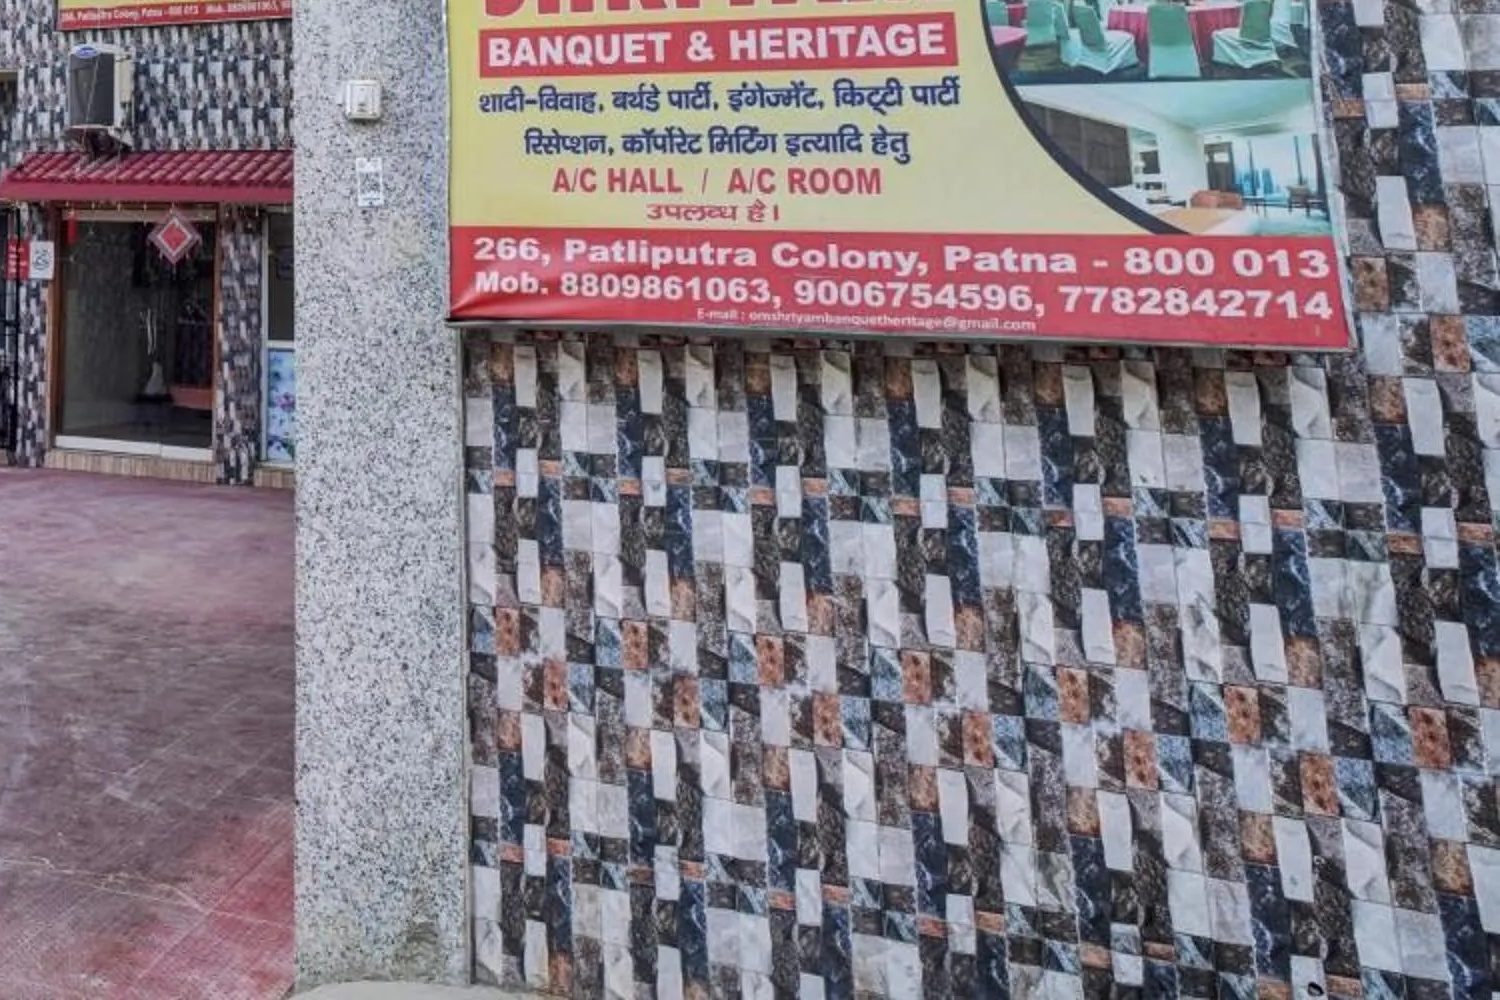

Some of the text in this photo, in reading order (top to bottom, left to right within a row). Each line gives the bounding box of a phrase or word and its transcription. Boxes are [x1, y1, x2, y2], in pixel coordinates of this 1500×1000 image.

[488, 22, 947, 68] BANQUET & HERITAGE
[909, 76, 961, 106] पार्टी
[783, 123, 864, 156] इत्यादि
[870, 124, 911, 164] हेतु
[552, 167, 598, 193] A/C
[607, 167, 683, 193] HALL
[726, 167, 776, 195] A/C
[787, 167, 882, 195] ROOM
[473, 237, 551, 267] 266,
[564, 238, 757, 270] Patliputra
[771, 242, 928, 276] Colony,
[943, 245, 1077, 273] Patna
[1123, 247, 1215, 277] 800
[1232, 249, 1330, 279] 013
[474, 270, 1333, 320] Mob. 8809861063, 9006754596, 7782842714
[696, 308, 737, 321] E-mail
